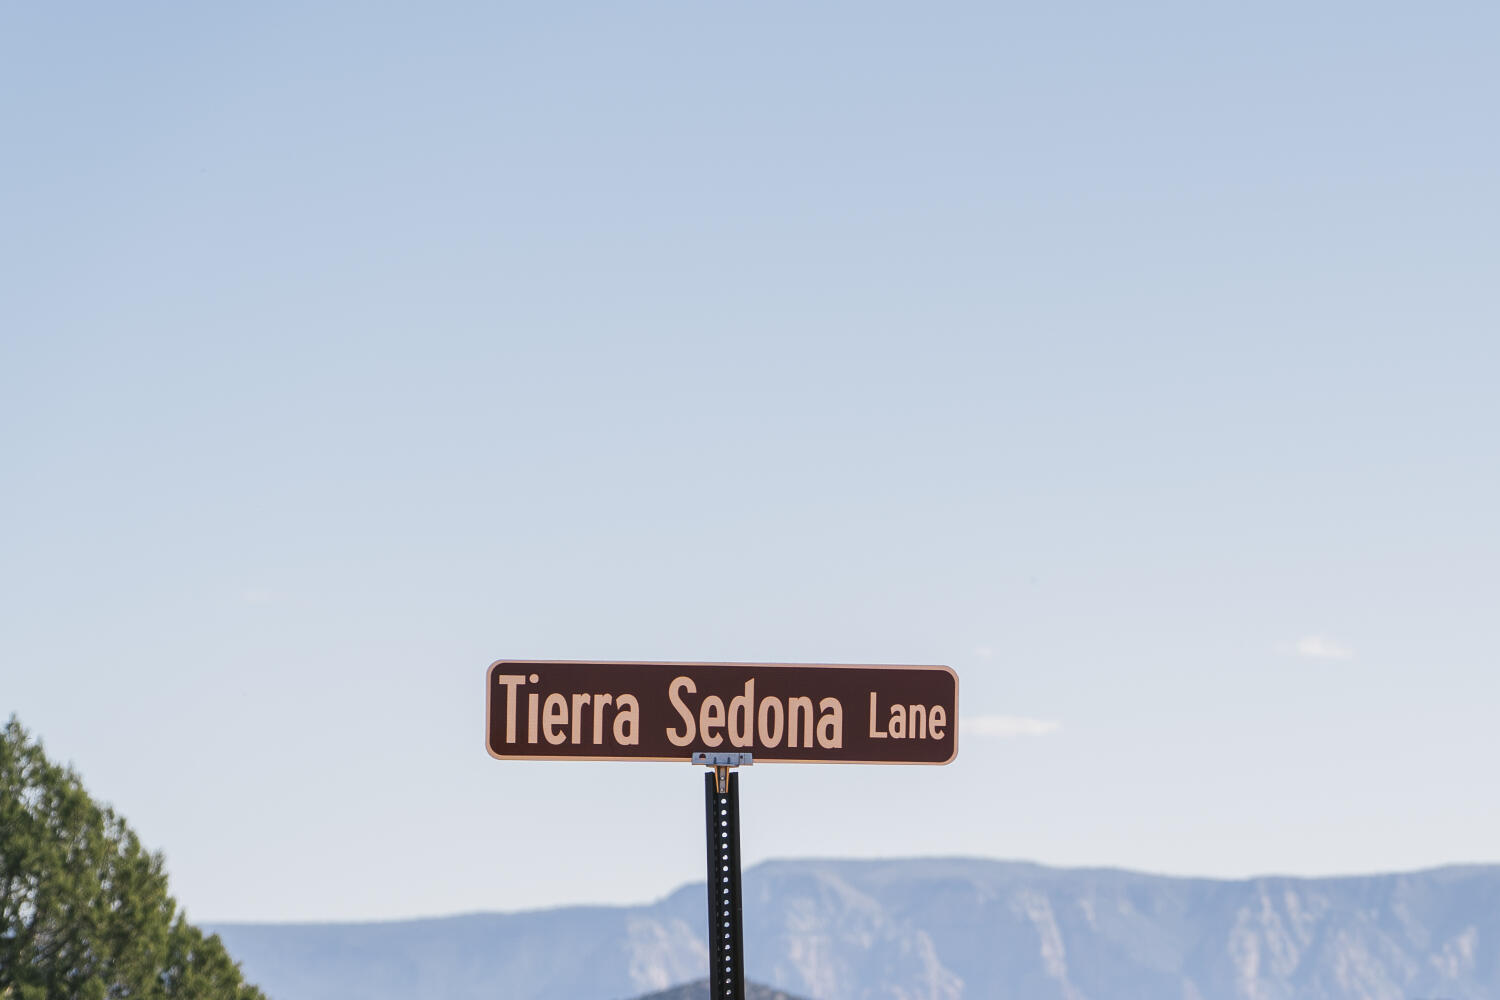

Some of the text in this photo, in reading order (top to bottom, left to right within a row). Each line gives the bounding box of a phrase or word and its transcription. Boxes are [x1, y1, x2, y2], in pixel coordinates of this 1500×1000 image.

[498, 673, 947, 749] Tierra Sedona Lane
